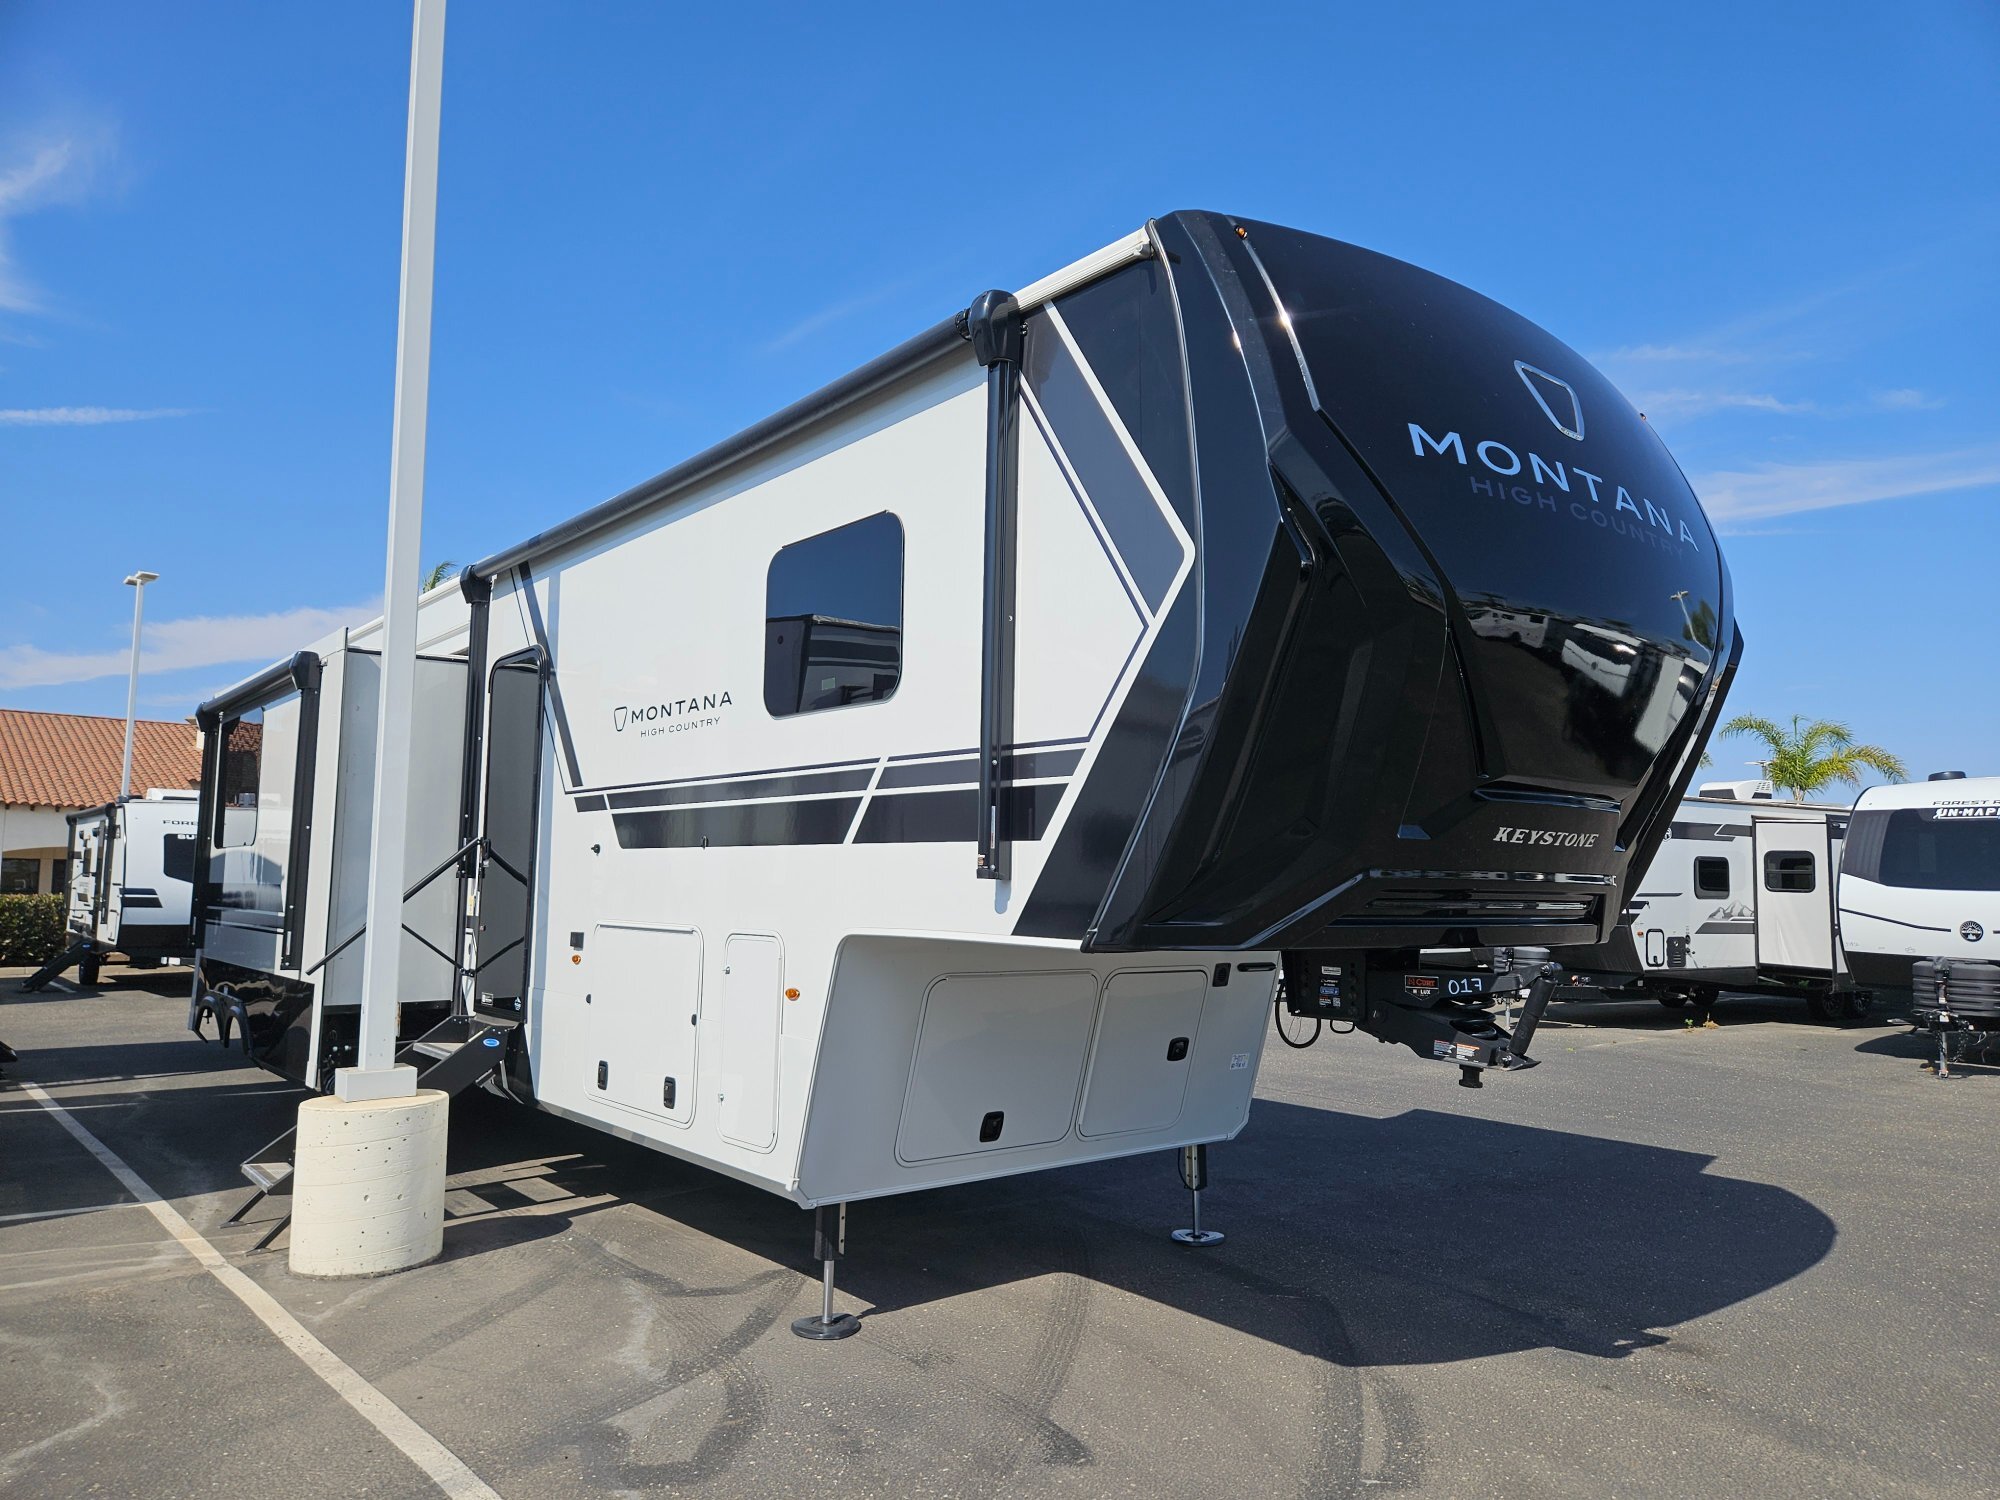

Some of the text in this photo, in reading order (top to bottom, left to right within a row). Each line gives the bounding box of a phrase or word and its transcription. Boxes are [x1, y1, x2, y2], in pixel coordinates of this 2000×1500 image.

[1408, 422, 1699, 552] MONTANA
[1470, 475, 1684, 560] HIGH COUNTRY
[631, 691, 732, 724] MONTANA
[640, 716, 721, 738] HIGH COUNTRY
[1493, 826, 1600, 848] KEYSTONE
[1448, 978, 1482, 995] 017
